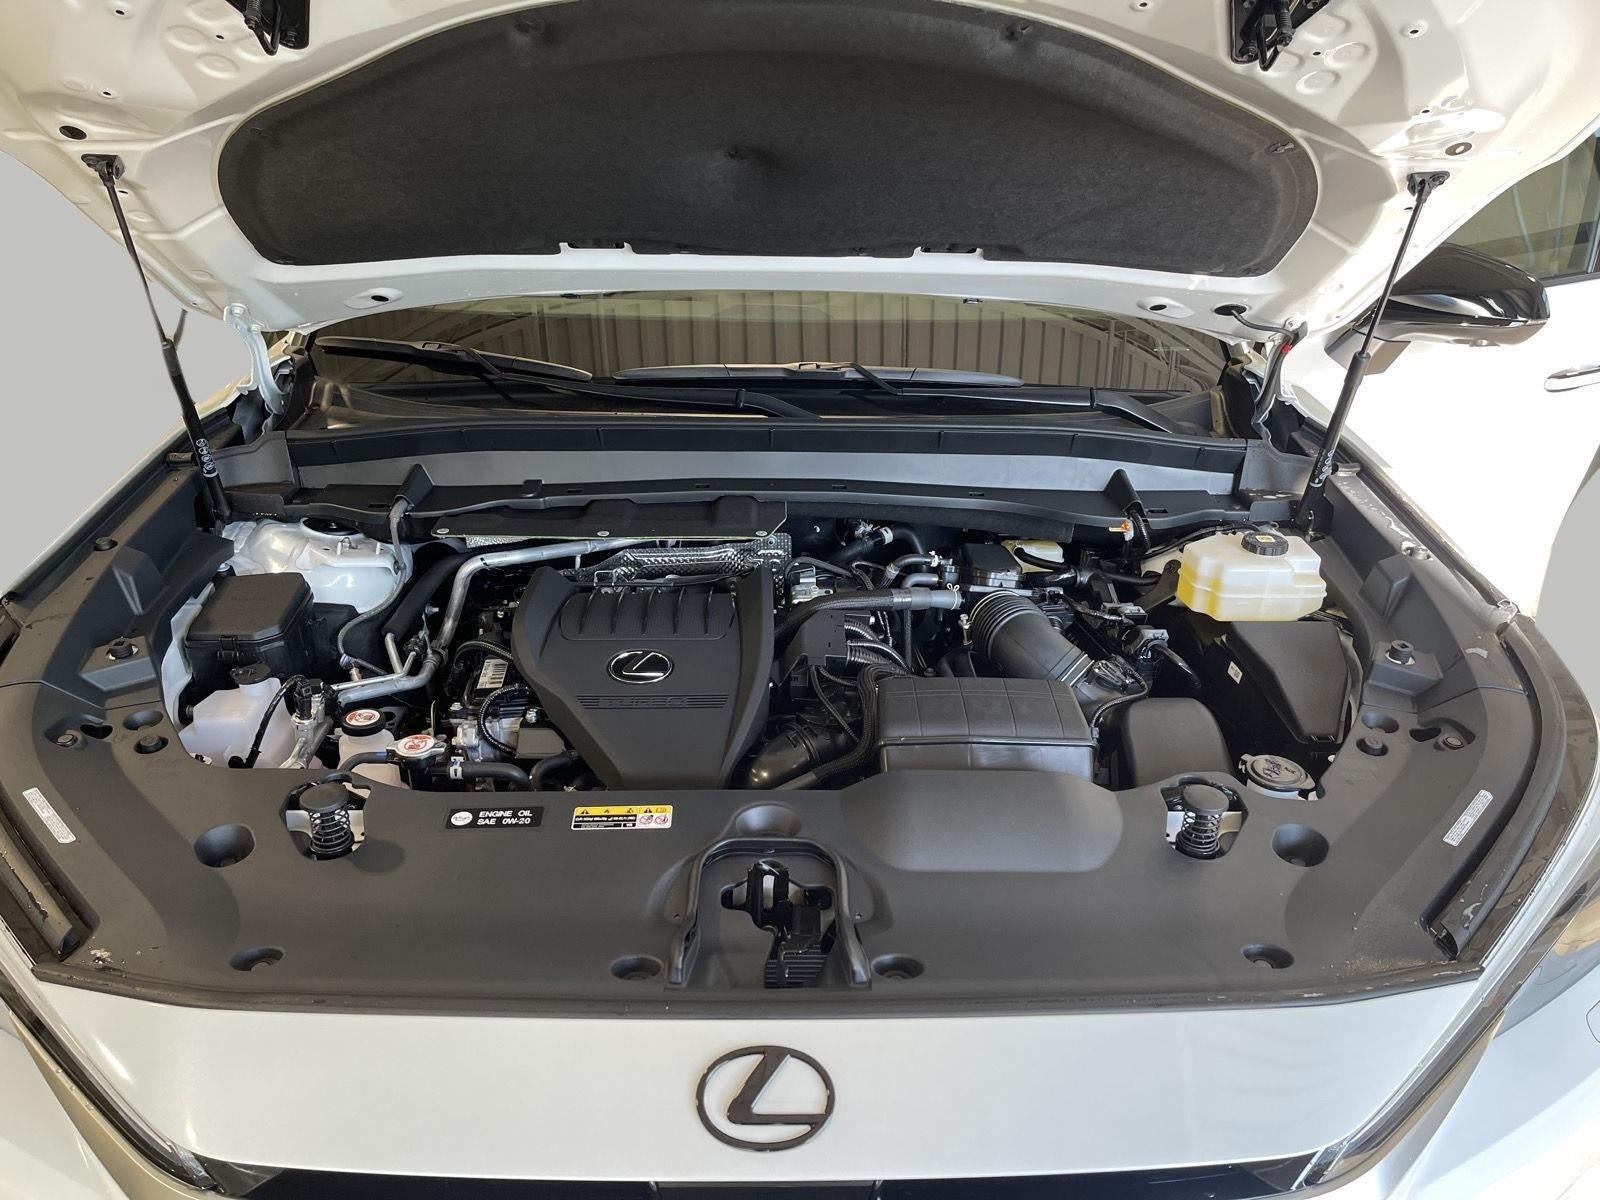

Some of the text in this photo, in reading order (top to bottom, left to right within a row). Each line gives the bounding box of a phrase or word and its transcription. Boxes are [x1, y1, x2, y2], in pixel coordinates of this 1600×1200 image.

[479, 810, 514, 818] ENGINE
[517, 809, 533, 817] OIL
[502, 817, 531, 825] 0W-20
